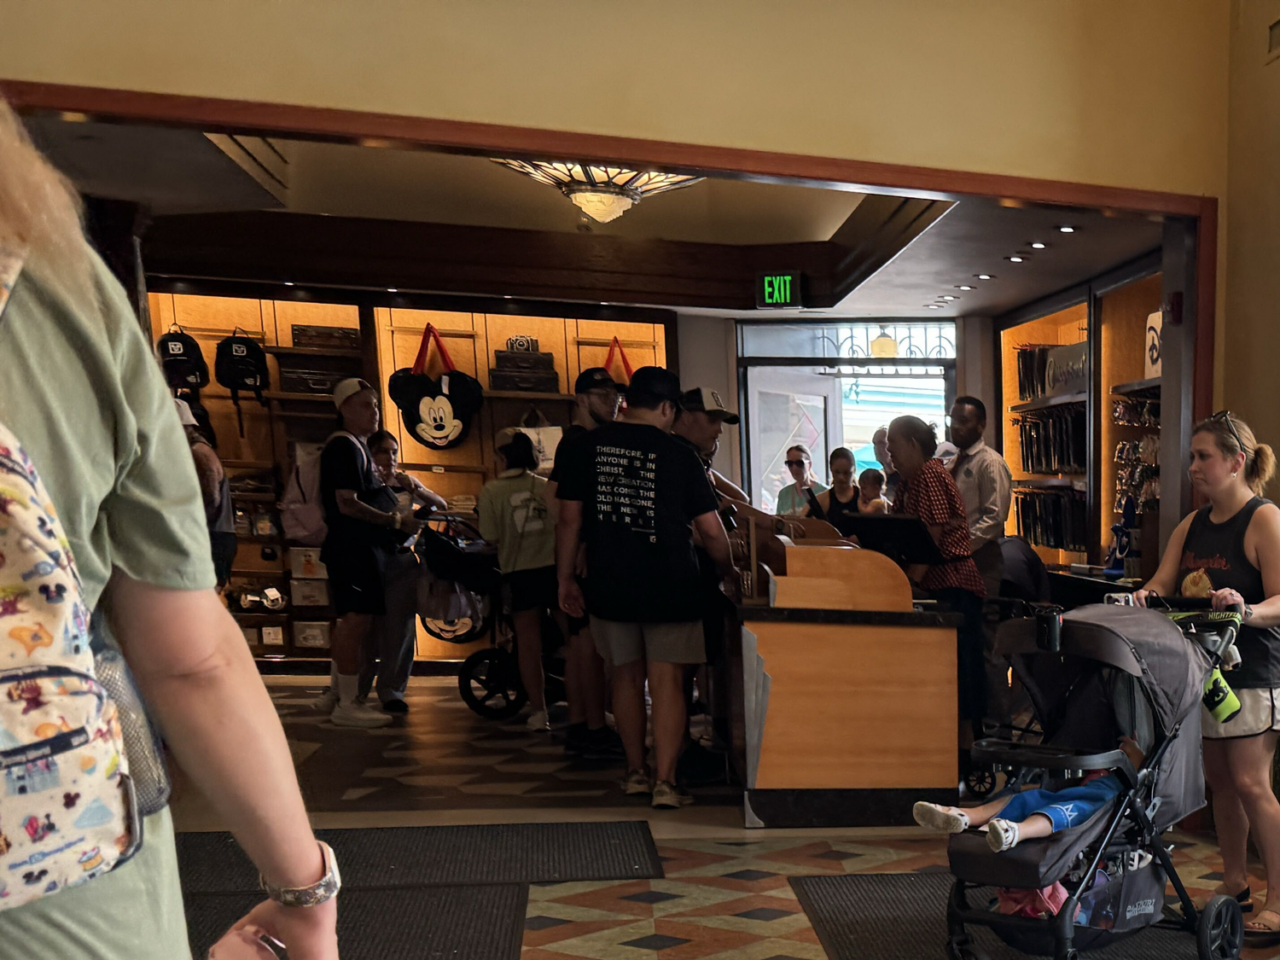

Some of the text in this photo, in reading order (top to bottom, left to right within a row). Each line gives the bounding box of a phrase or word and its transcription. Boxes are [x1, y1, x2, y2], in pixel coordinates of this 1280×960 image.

[764, 275, 792, 303] EXIT
[595, 455, 629, 465] ANYONE
[646, 462, 656, 470] IN
[640, 470, 655, 479] THE
[639, 490, 655, 498] THE
[614, 496, 631, 505] HAS
[597, 504, 612, 512] THE
[646, 509, 655, 517] IS
